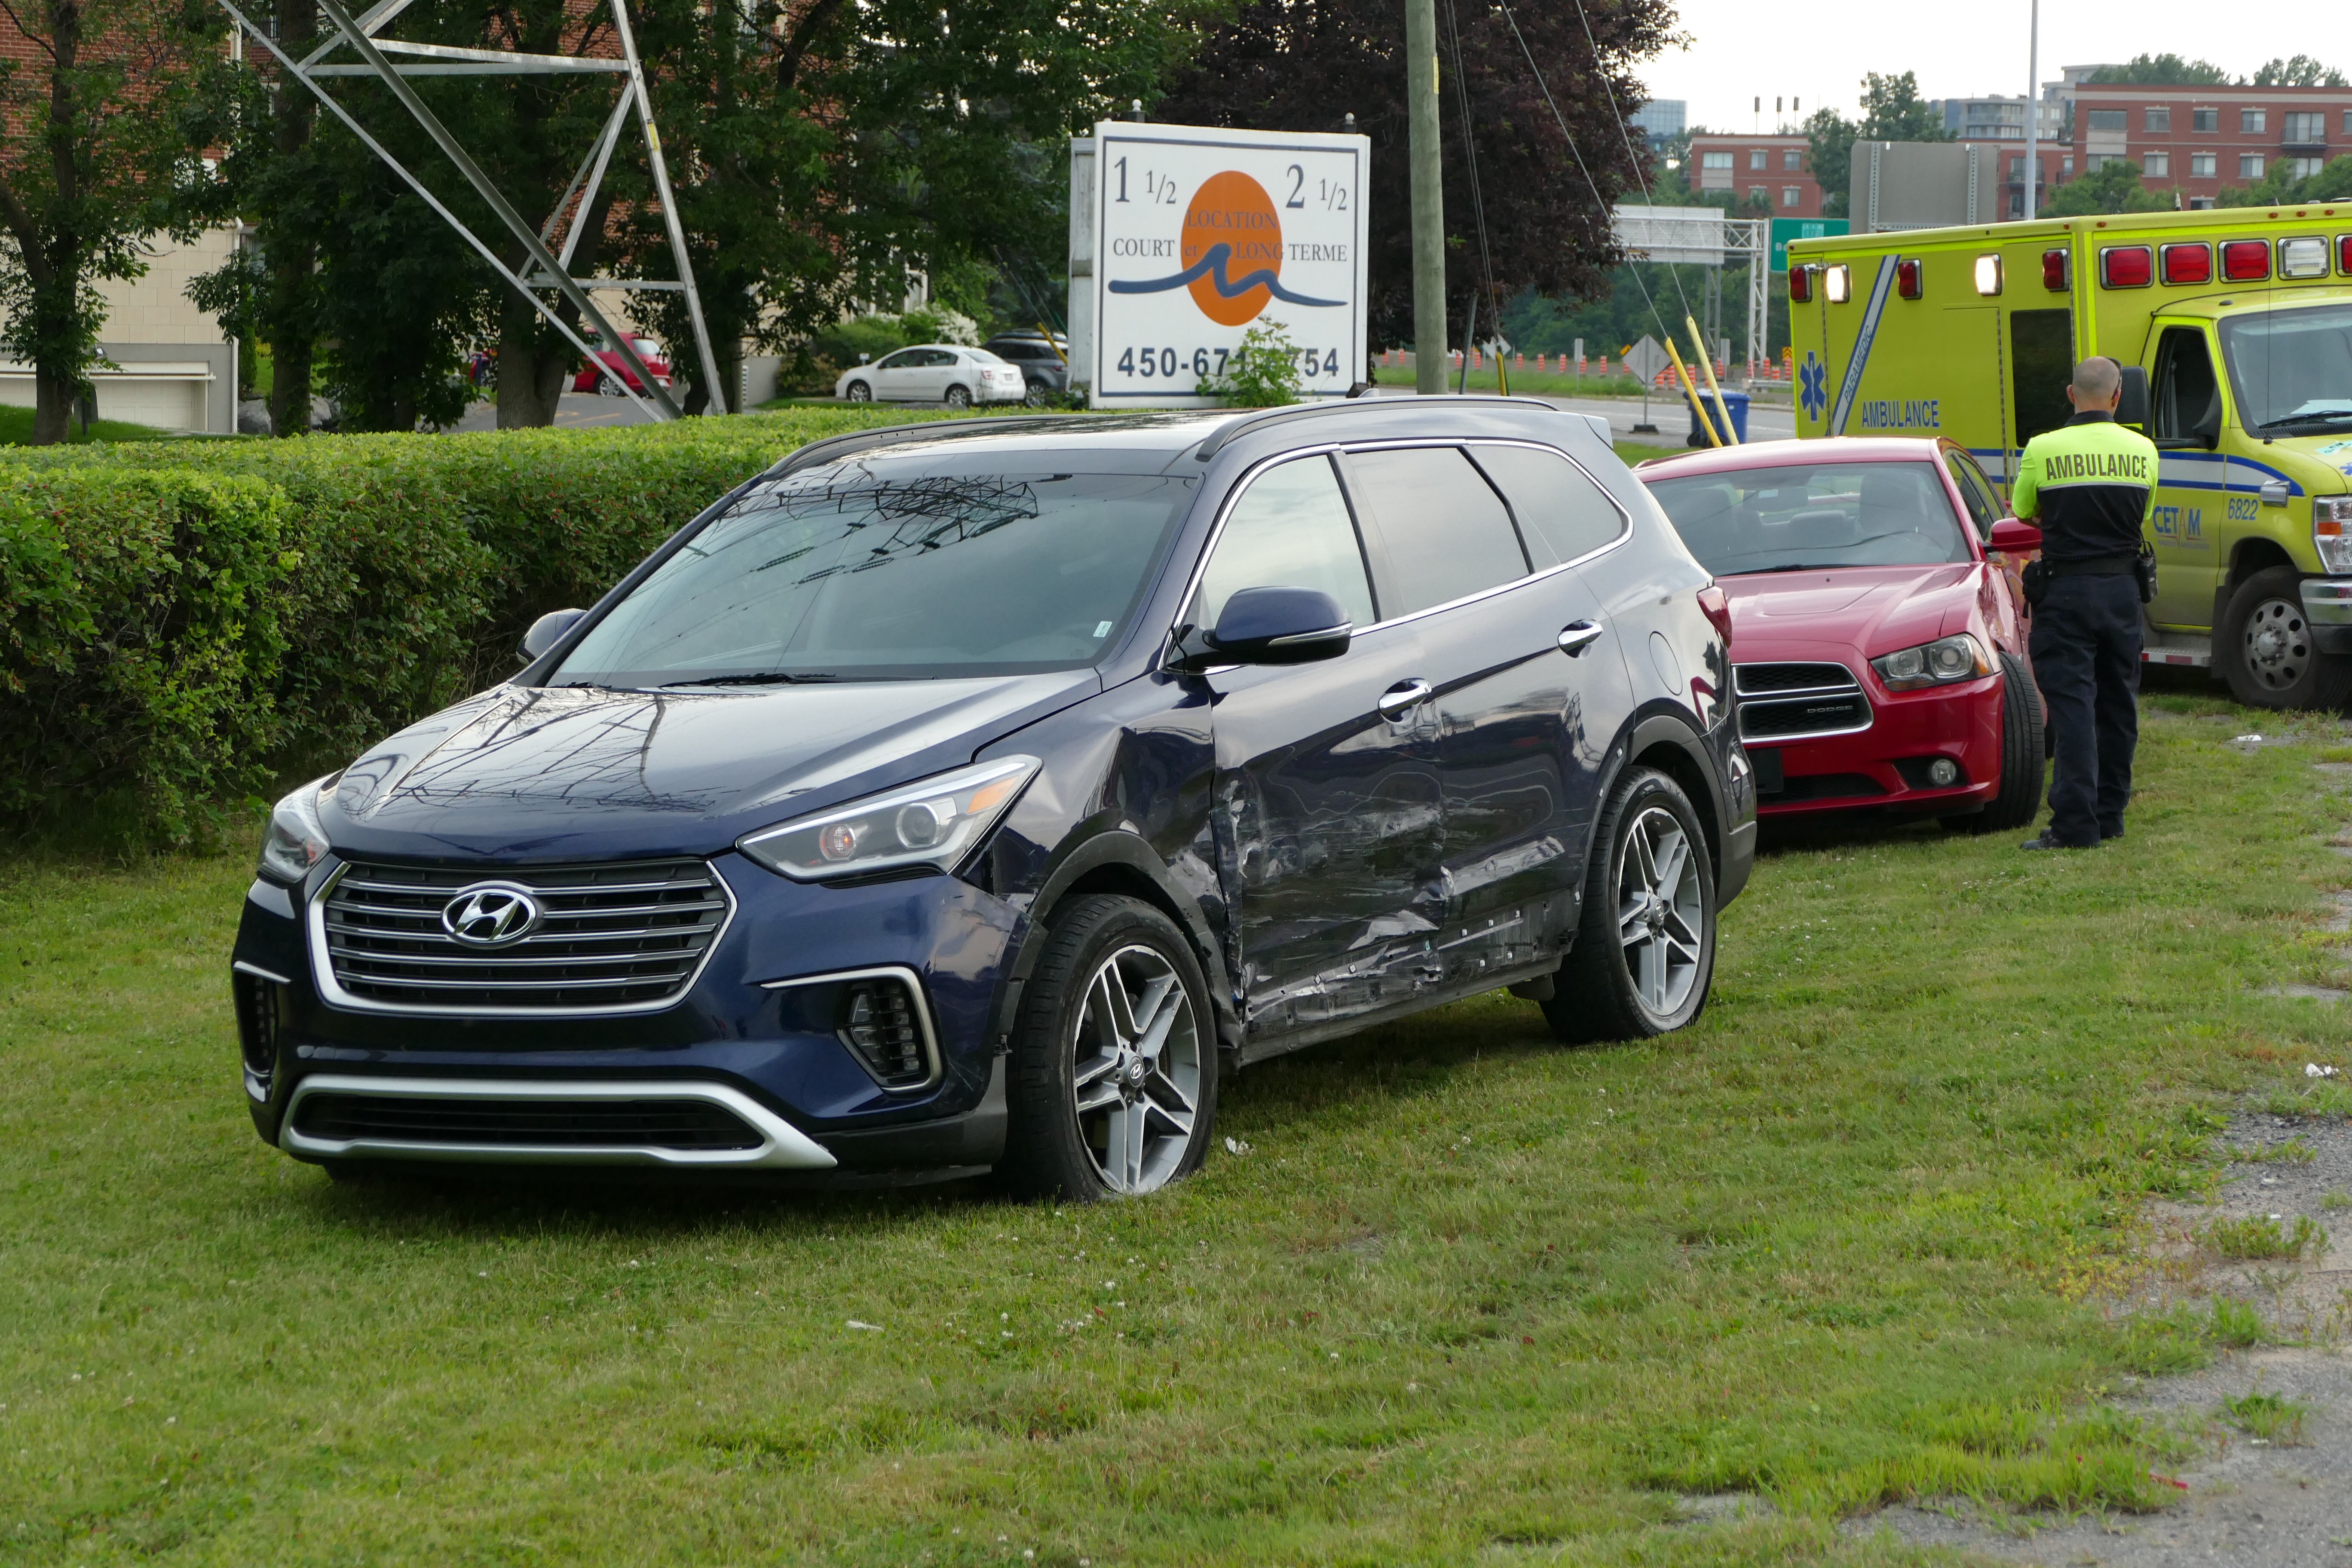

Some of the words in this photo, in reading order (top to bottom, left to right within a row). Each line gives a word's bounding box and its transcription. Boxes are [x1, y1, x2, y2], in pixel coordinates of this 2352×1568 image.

[1114, 156, 1130, 202] 1
[1286, 162, 1305, 208] 2
[1187, 209, 1277, 229] LOCATION
[1113, 238, 1175, 257] COURT
[1185, 244, 1197, 257] et
[1235, 242, 1283, 260] LONG
[1288, 243, 1348, 261] TERME
[1844, 325, 1871, 404] PARAMEDIC
[1862, 400, 1940, 428] AMBULANCE
[2046, 454, 2147, 481] AMBULANCE
[2153, 505, 2201, 536] CETAM
[2228, 498, 2258, 521] 6822
